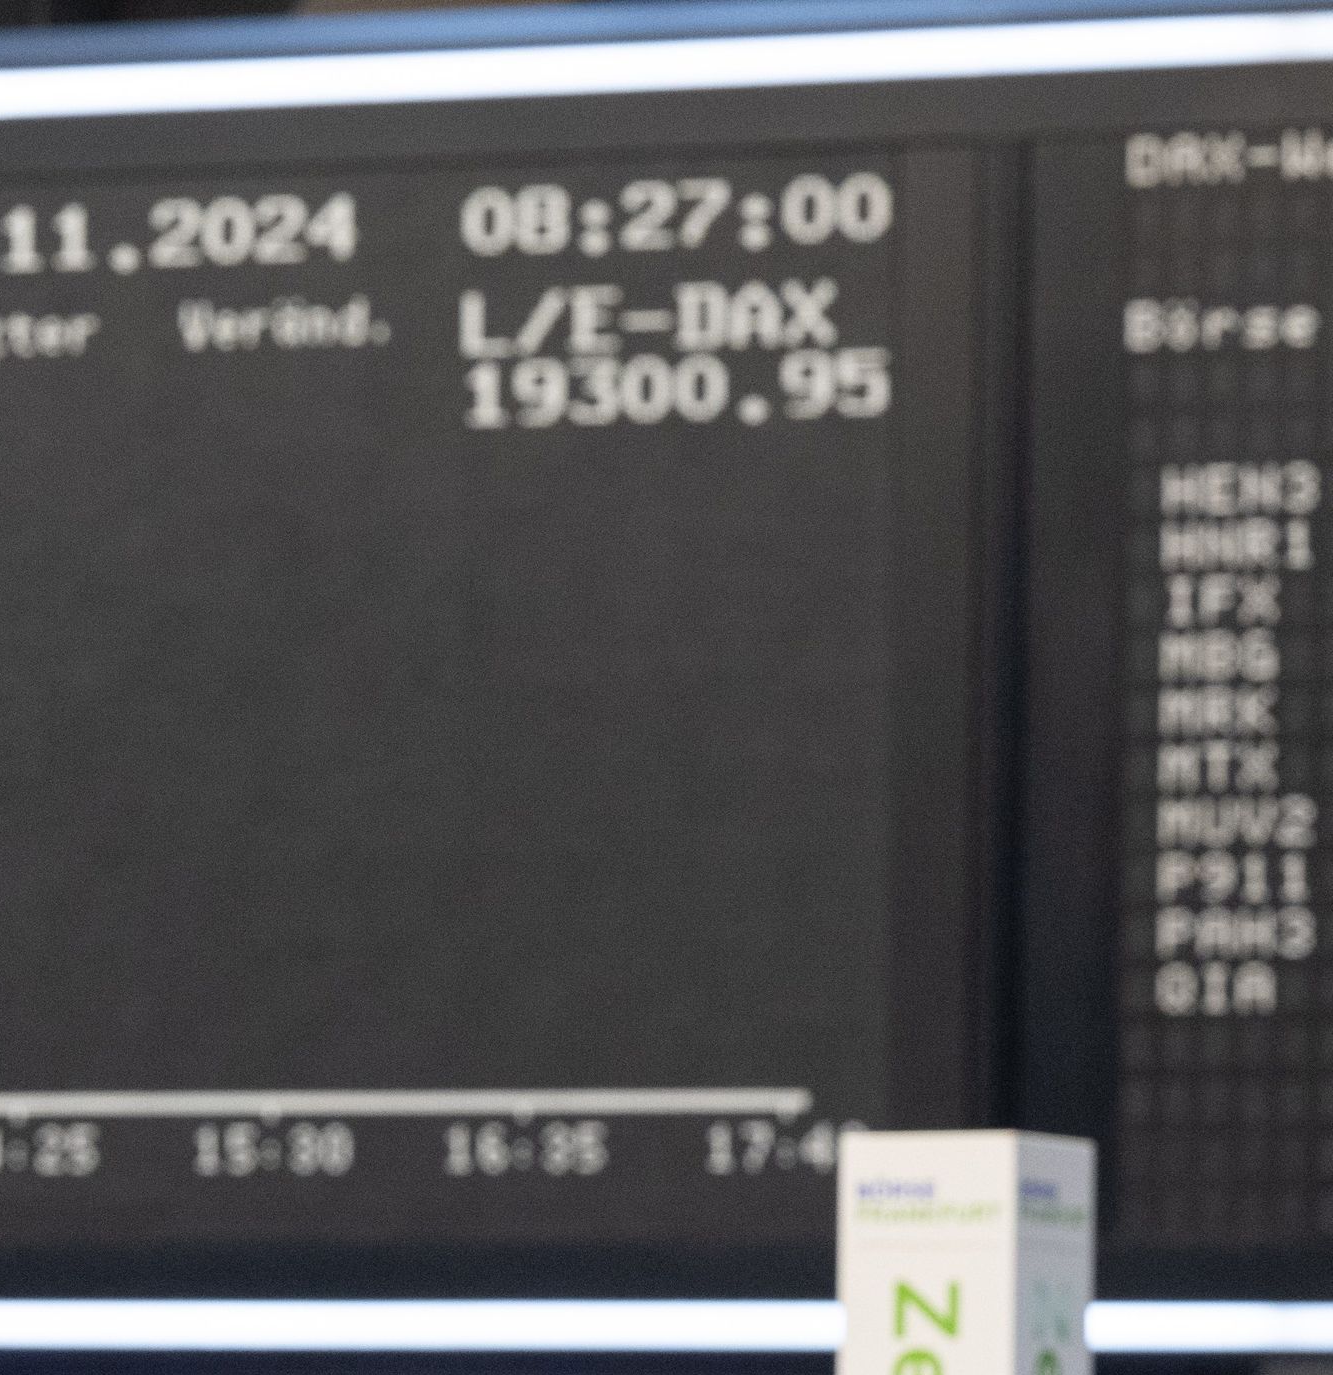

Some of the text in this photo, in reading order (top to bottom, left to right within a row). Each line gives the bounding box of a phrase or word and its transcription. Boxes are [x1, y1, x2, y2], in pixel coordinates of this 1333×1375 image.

[1125, 130, 1333, 187] DAX-W
[461, 173, 893, 258] 08:27:00
[460, 279, 837, 357] L/E-DAX
[464, 347, 892, 430] 19300.95
[706, 1118, 868, 1176] 17:4
